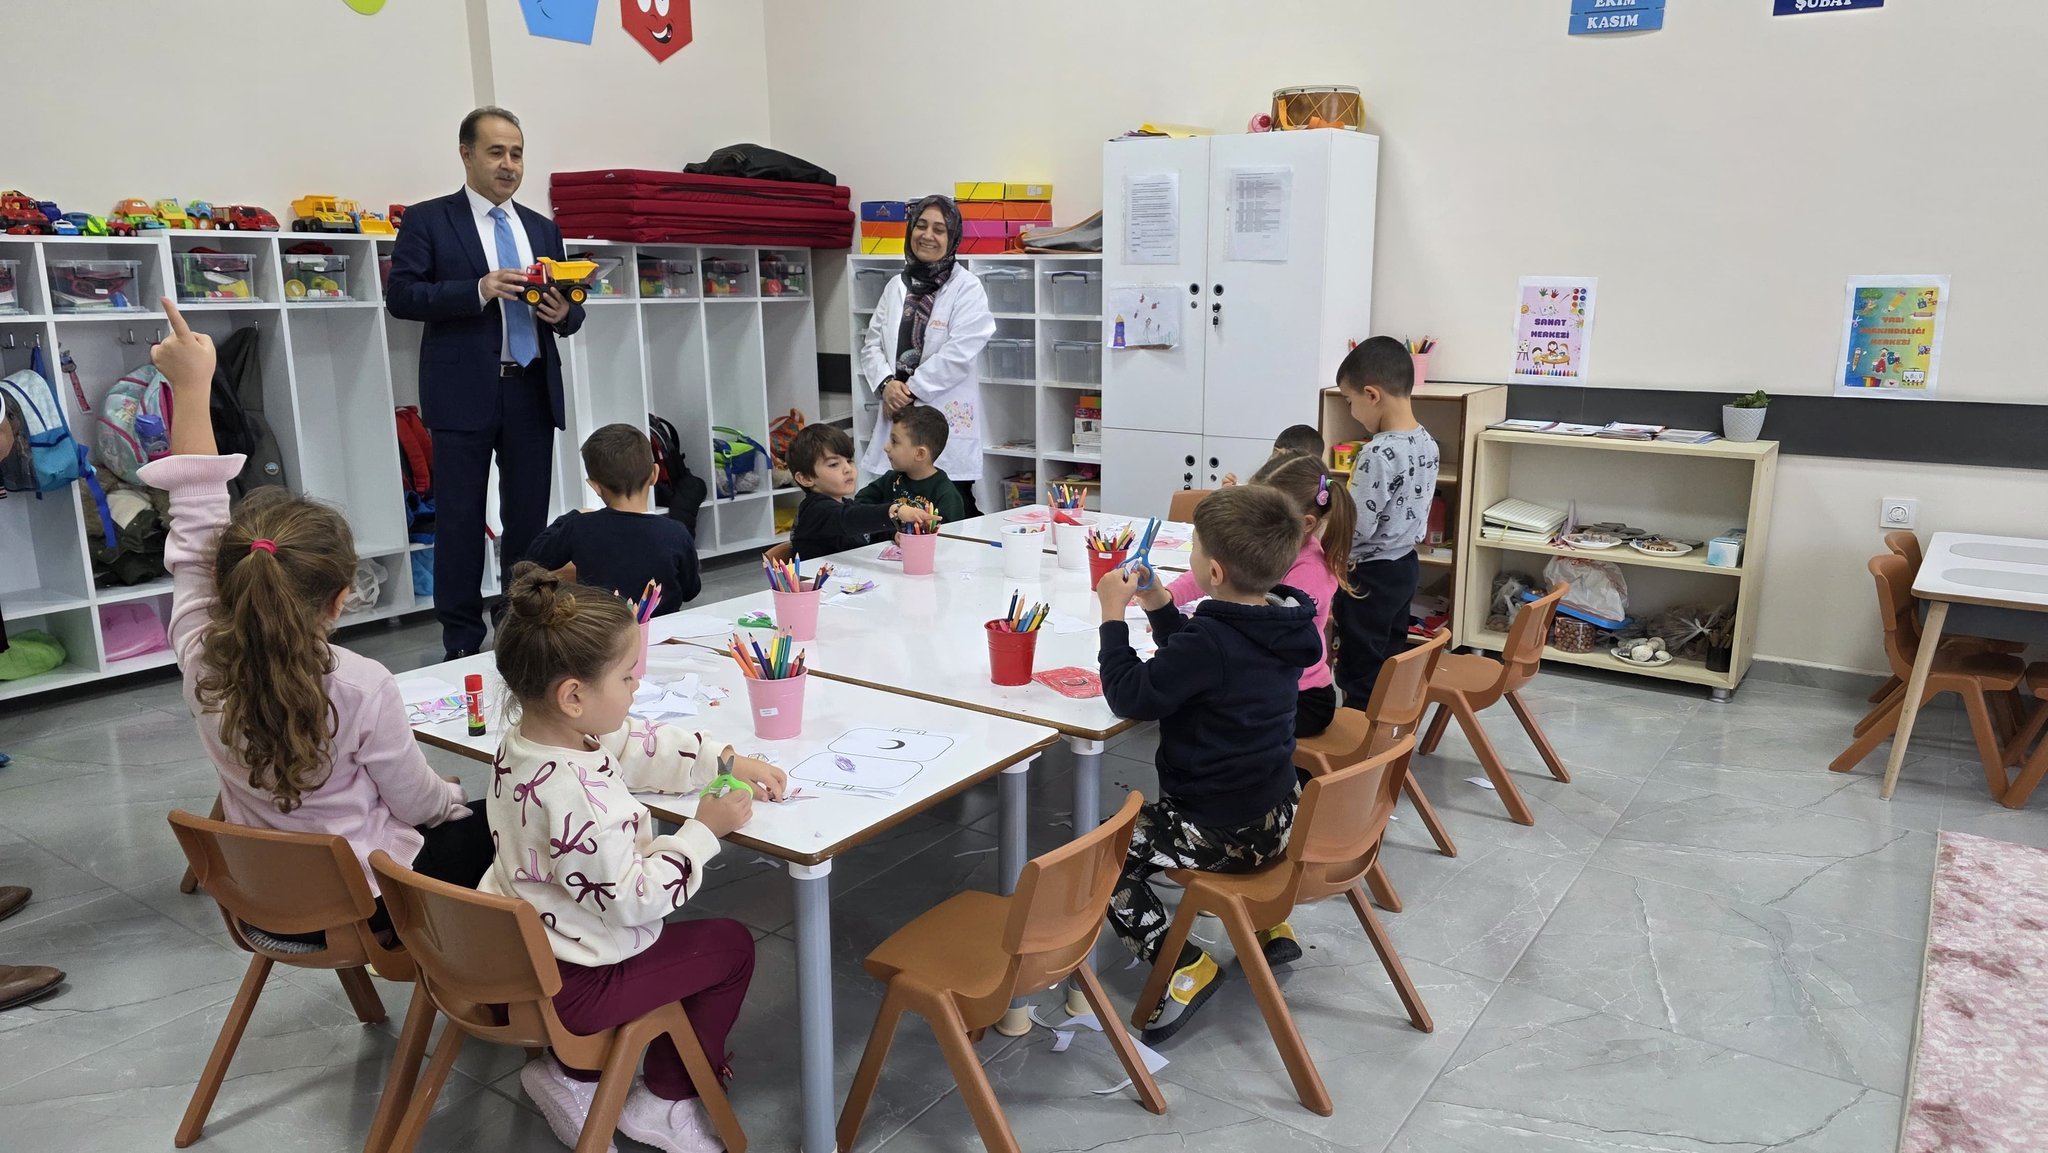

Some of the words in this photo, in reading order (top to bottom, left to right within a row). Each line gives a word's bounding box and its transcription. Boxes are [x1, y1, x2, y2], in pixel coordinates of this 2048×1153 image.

[1586, 14, 1639, 29] KASIM
[1534, 318, 1567, 326] SANAT
[1530, 330, 1569, 339] MERKEZİ
